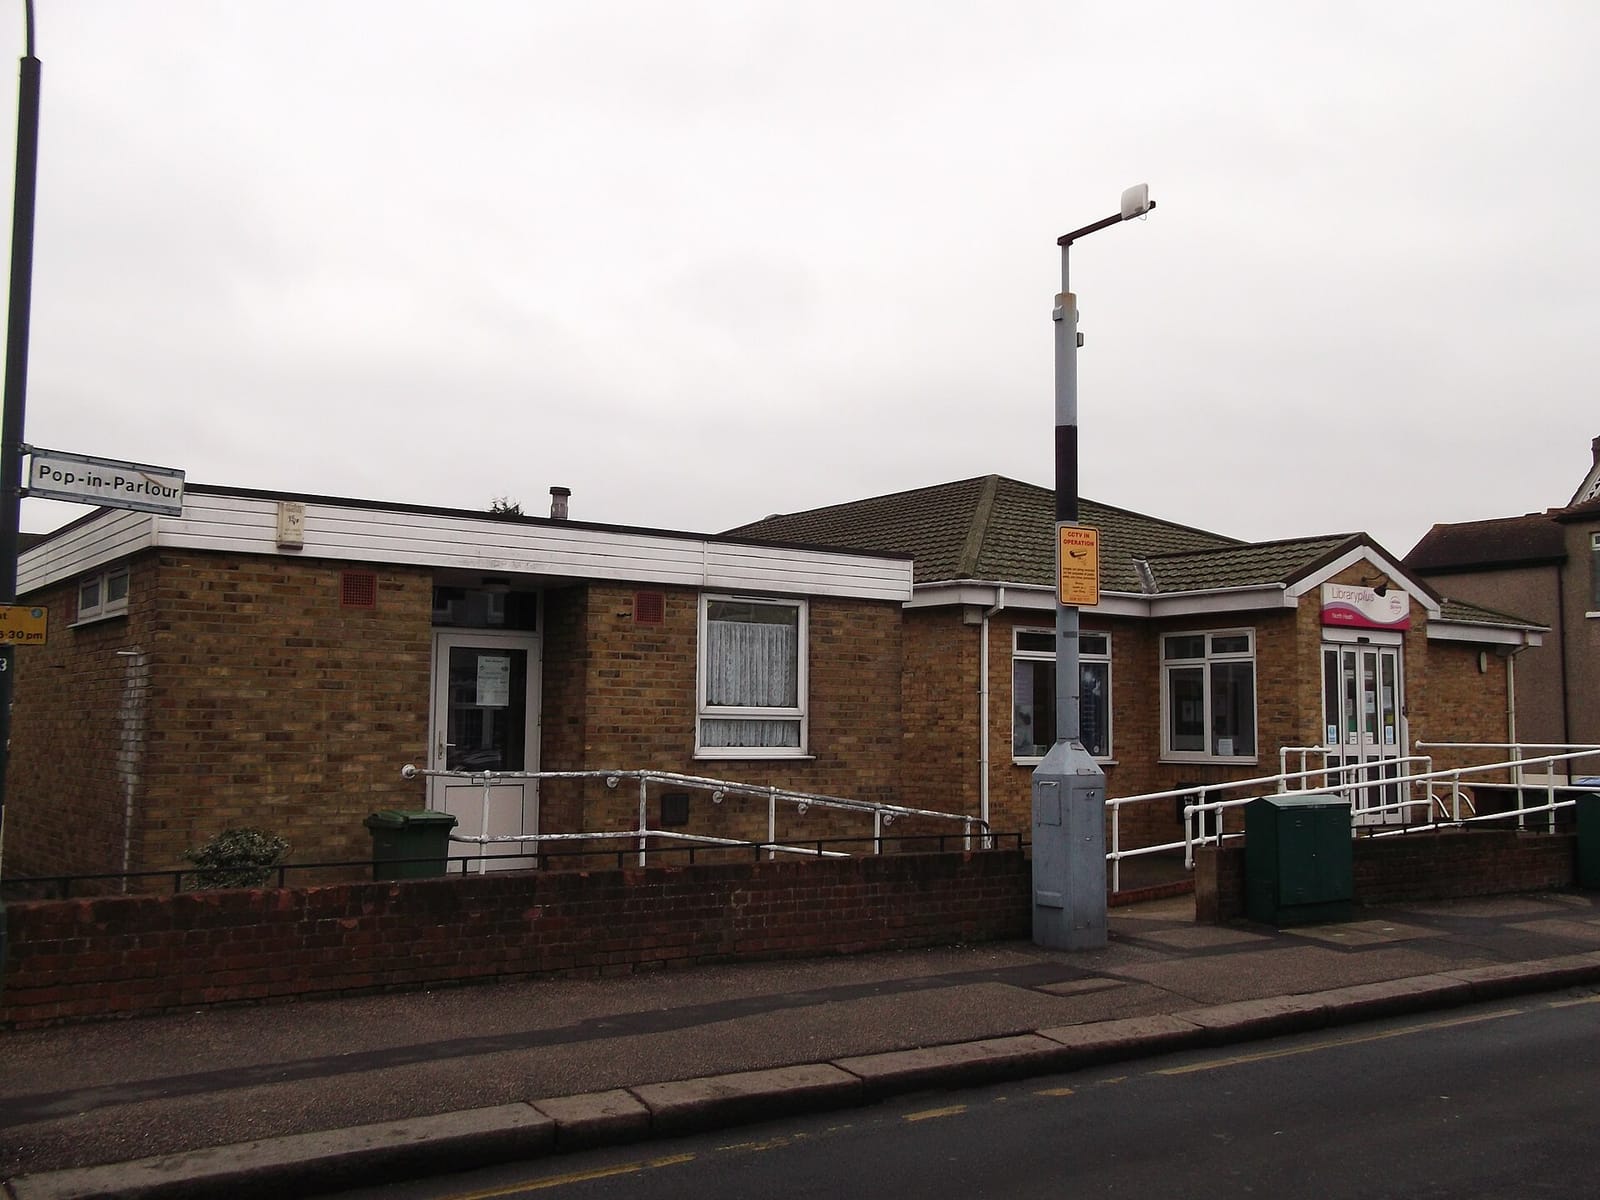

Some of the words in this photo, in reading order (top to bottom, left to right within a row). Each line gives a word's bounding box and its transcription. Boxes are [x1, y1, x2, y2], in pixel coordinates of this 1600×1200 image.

[39, 464, 179, 499] Pop-in-Parlour
[1063, 538, 1095, 547] OPERATION
[26, 632, 43, 640] pm
